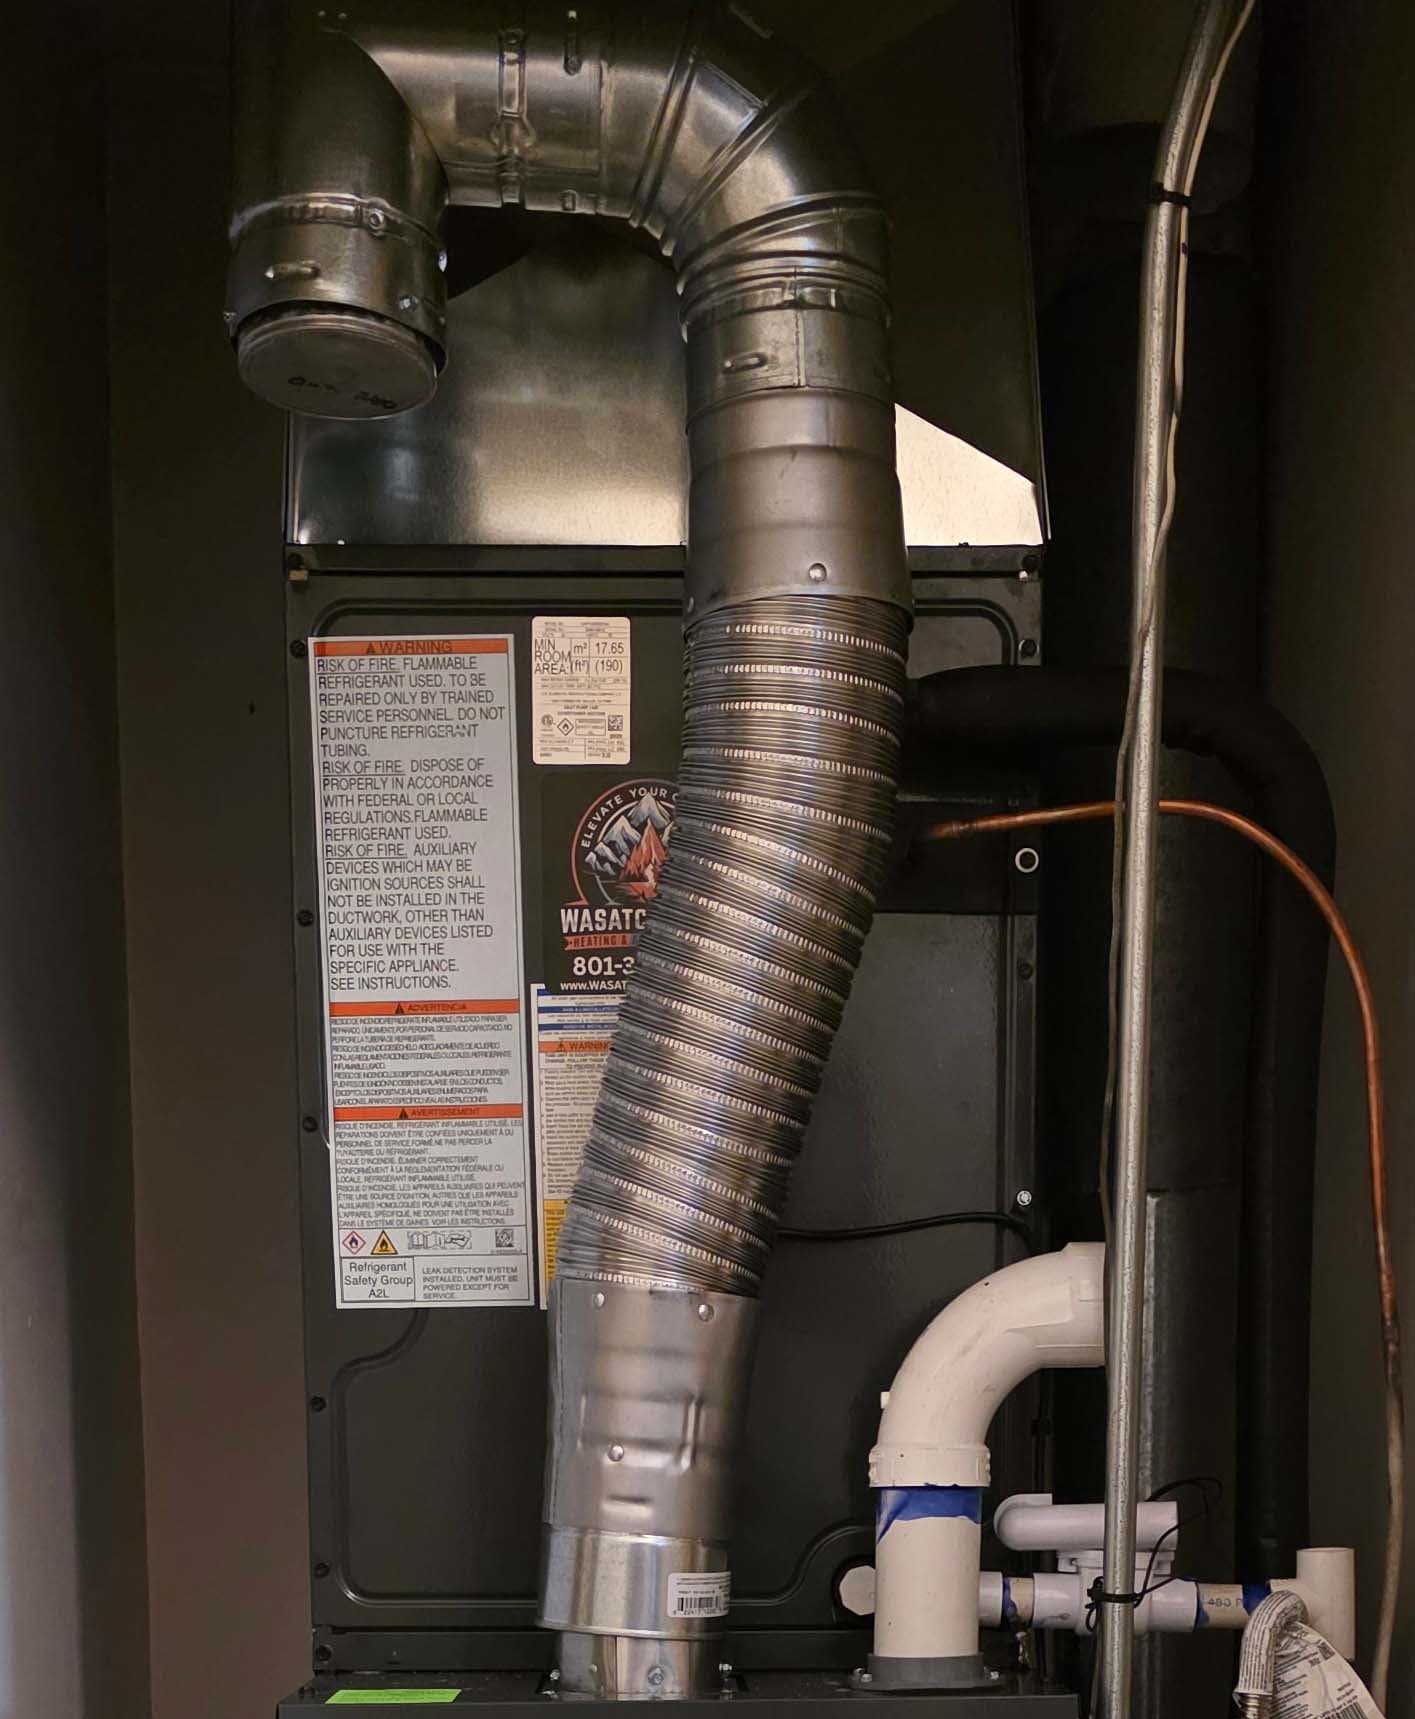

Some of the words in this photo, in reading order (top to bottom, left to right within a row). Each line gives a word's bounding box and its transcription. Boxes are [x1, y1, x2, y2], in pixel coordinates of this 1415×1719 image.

[384, 640, 452, 654] WARNING
[535, 639, 555, 650] MIN
[596, 642, 624, 654] 17.65
[535, 651, 571, 662] ROOM
[317, 659, 344, 672] RISK
[349, 659, 364, 671] OF
[403, 657, 477, 670] FLAMMABLE
[534, 662, 568, 674] AREA:
[595, 659, 623, 674] (190)
[319, 675, 405, 689] REFRIGERANT
[409, 675, 445, 687] USED.
[450, 674, 466, 686] TO
[471, 673, 486, 686] BE
[319, 692, 380, 706] REPAIRED
[384, 692, 417, 705] ONLY
[421, 691, 437, 704] BY
[441, 690, 494, 704] TRAINED
[320, 709, 373, 723] SERVICE
[458, 707, 475, 720] DO
[480, 707, 505, 719] NOT
[321, 726, 387, 741] PUNCTURE
[392, 724, 479, 739] REFRIGERANT
[321, 744, 369, 757] TUBING.
[323, 761, 350, 774] RISK
[354, 760, 370, 773] OF
[411, 758, 463, 772] DISPOSE
[467, 758, 484, 771] OF
[323, 777, 388, 791] PROPERLY
[392, 777, 403, 789] IN
[407, 775, 493, 789] ACCORDANCE
[323, 794, 354, 808] WITH
[358, 793, 414, 807] FEDERAL
[417, 793, 435, 806] OR
[439, 792, 478, 805] LOCAL
[581, 794, 623, 848] ELEVATE
[629, 787, 668, 798] YOUR
[325, 827, 411, 841] REFRIGERANT
[415, 826, 451, 839] USED.
[326, 844, 353, 857] RISK
[356, 844, 373, 857] OF
[414, 842, 477, 856] AUXILIARY
[326, 861, 379, 874] DEVICES
[382, 860, 423, 873] WHICH
[426, 860, 453, 872] MAY
[457, 859, 472, 871] BE
[327, 878, 380, 891] IGNITION
[384, 877, 444, 890] SOURCES
[447, 876, 485, 889] SHALL
[327, 895, 353, 908] NOT
[357, 894, 372, 907] BE
[376, 893, 441, 906] INSTALLED
[445, 893, 456, 905] IN
[460, 892, 485, 905] THE
[406, 910, 448, 922] OTHER
[451, 909, 484, 922] THAN
[560, 909, 647, 933] WASATC
[329, 927, 391, 941] AUXILIARY
[395, 926, 447, 939] DEVICES
[451, 925, 493, 938] LISTED
[329, 944, 355, 957] FOR
[359, 944, 383, 957] USE
[386, 943, 417, 956] WITH
[420, 943, 444, 955] THE
[330, 960, 385, 974] SPECIFIC
[389, 959, 459, 973] APPLIANCE.
[573, 956, 635, 975] 801-3
[331, 977, 354, 990] SEE
[359, 976, 451, 989] INSTRUCTIONS.
[560, 981, 627, 990] www.WASAT
[350, 1262, 407, 1274] Refrigerant
[344, 1276, 377, 1287] Safety
[381, 1276, 413, 1286] Group
[369, 1289, 388, 1298] A2L
